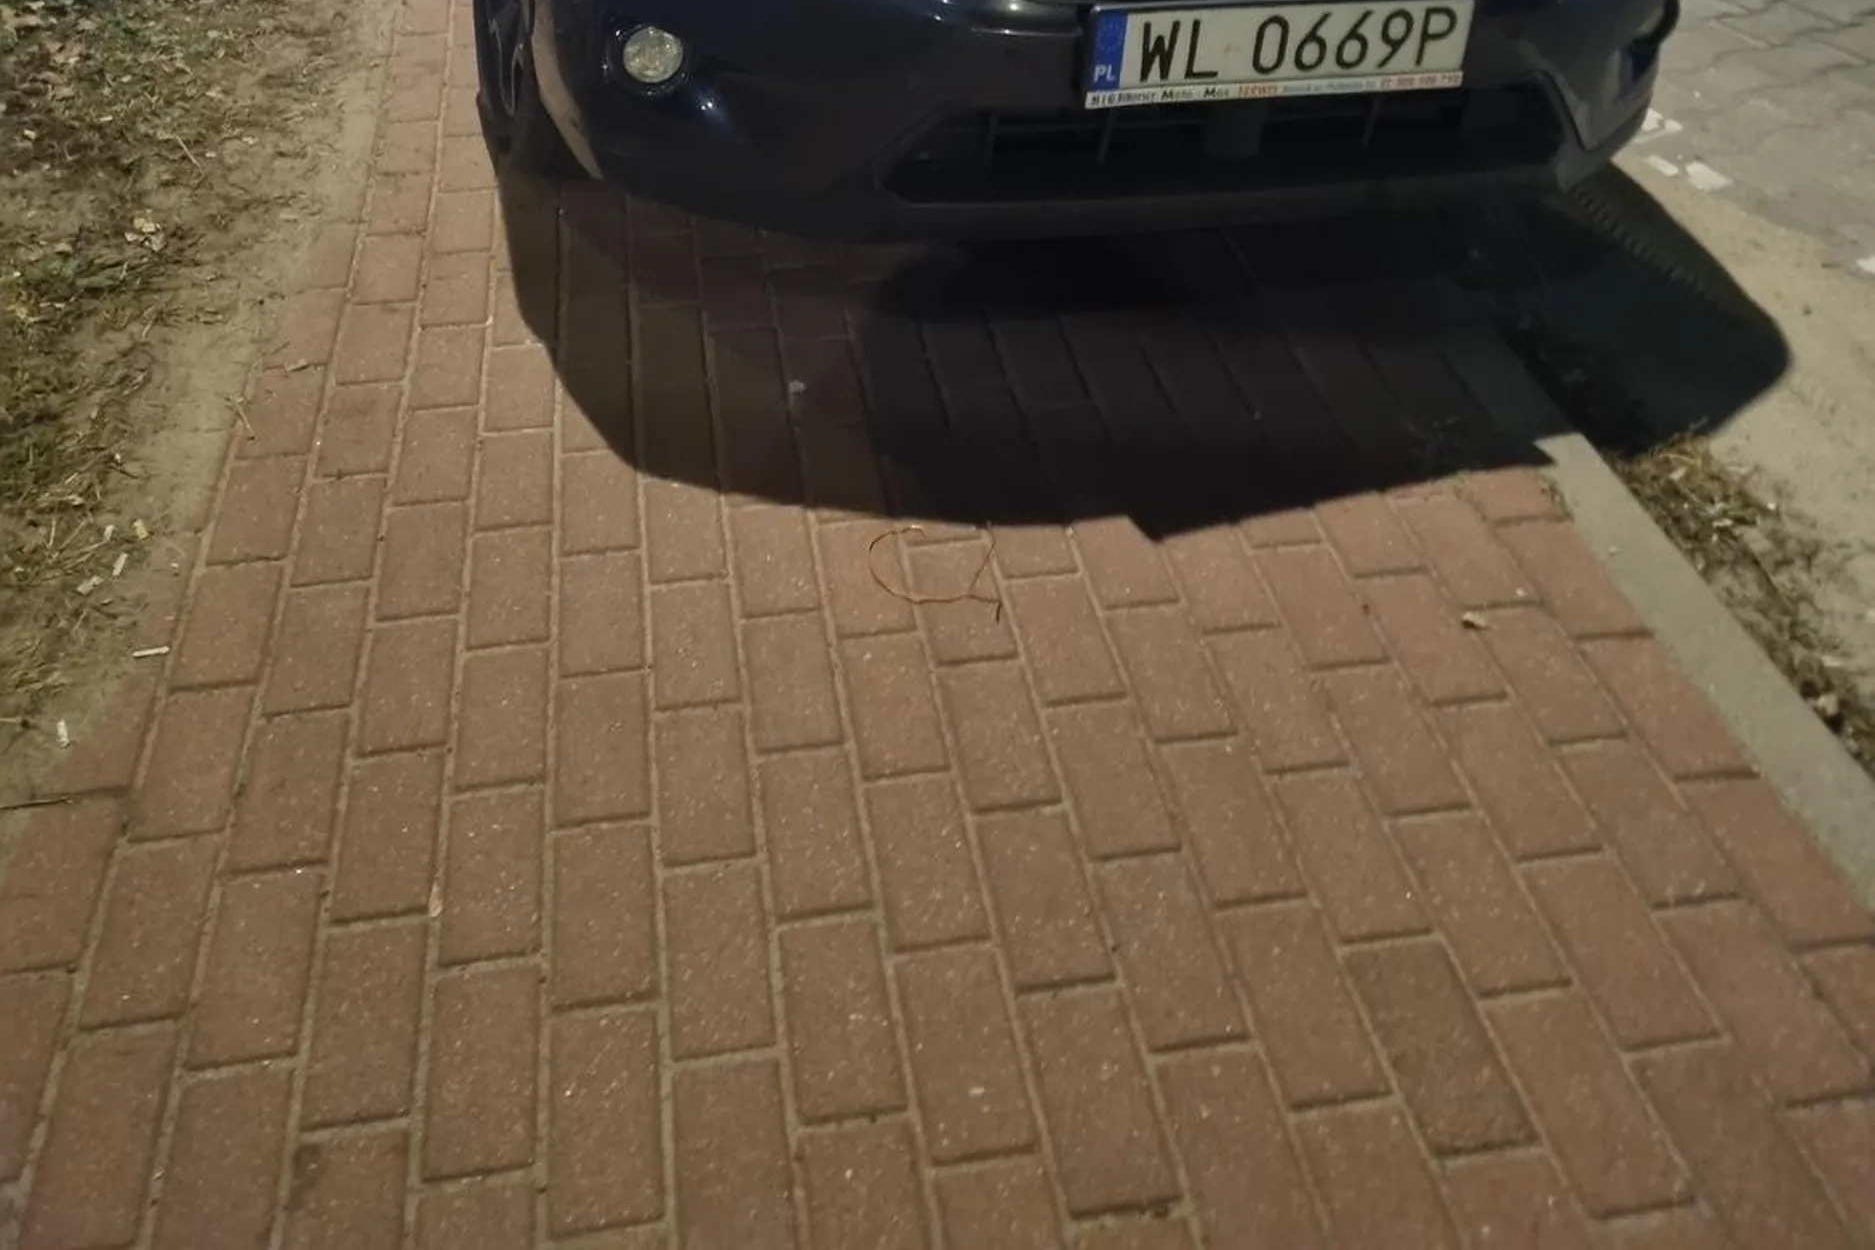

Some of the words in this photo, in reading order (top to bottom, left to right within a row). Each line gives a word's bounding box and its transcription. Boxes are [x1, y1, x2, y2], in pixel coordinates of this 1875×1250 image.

[1140, 18, 1218, 82] WL
[1252, 7, 1458, 74] 0669P
[1094, 64, 1116, 82] PL
